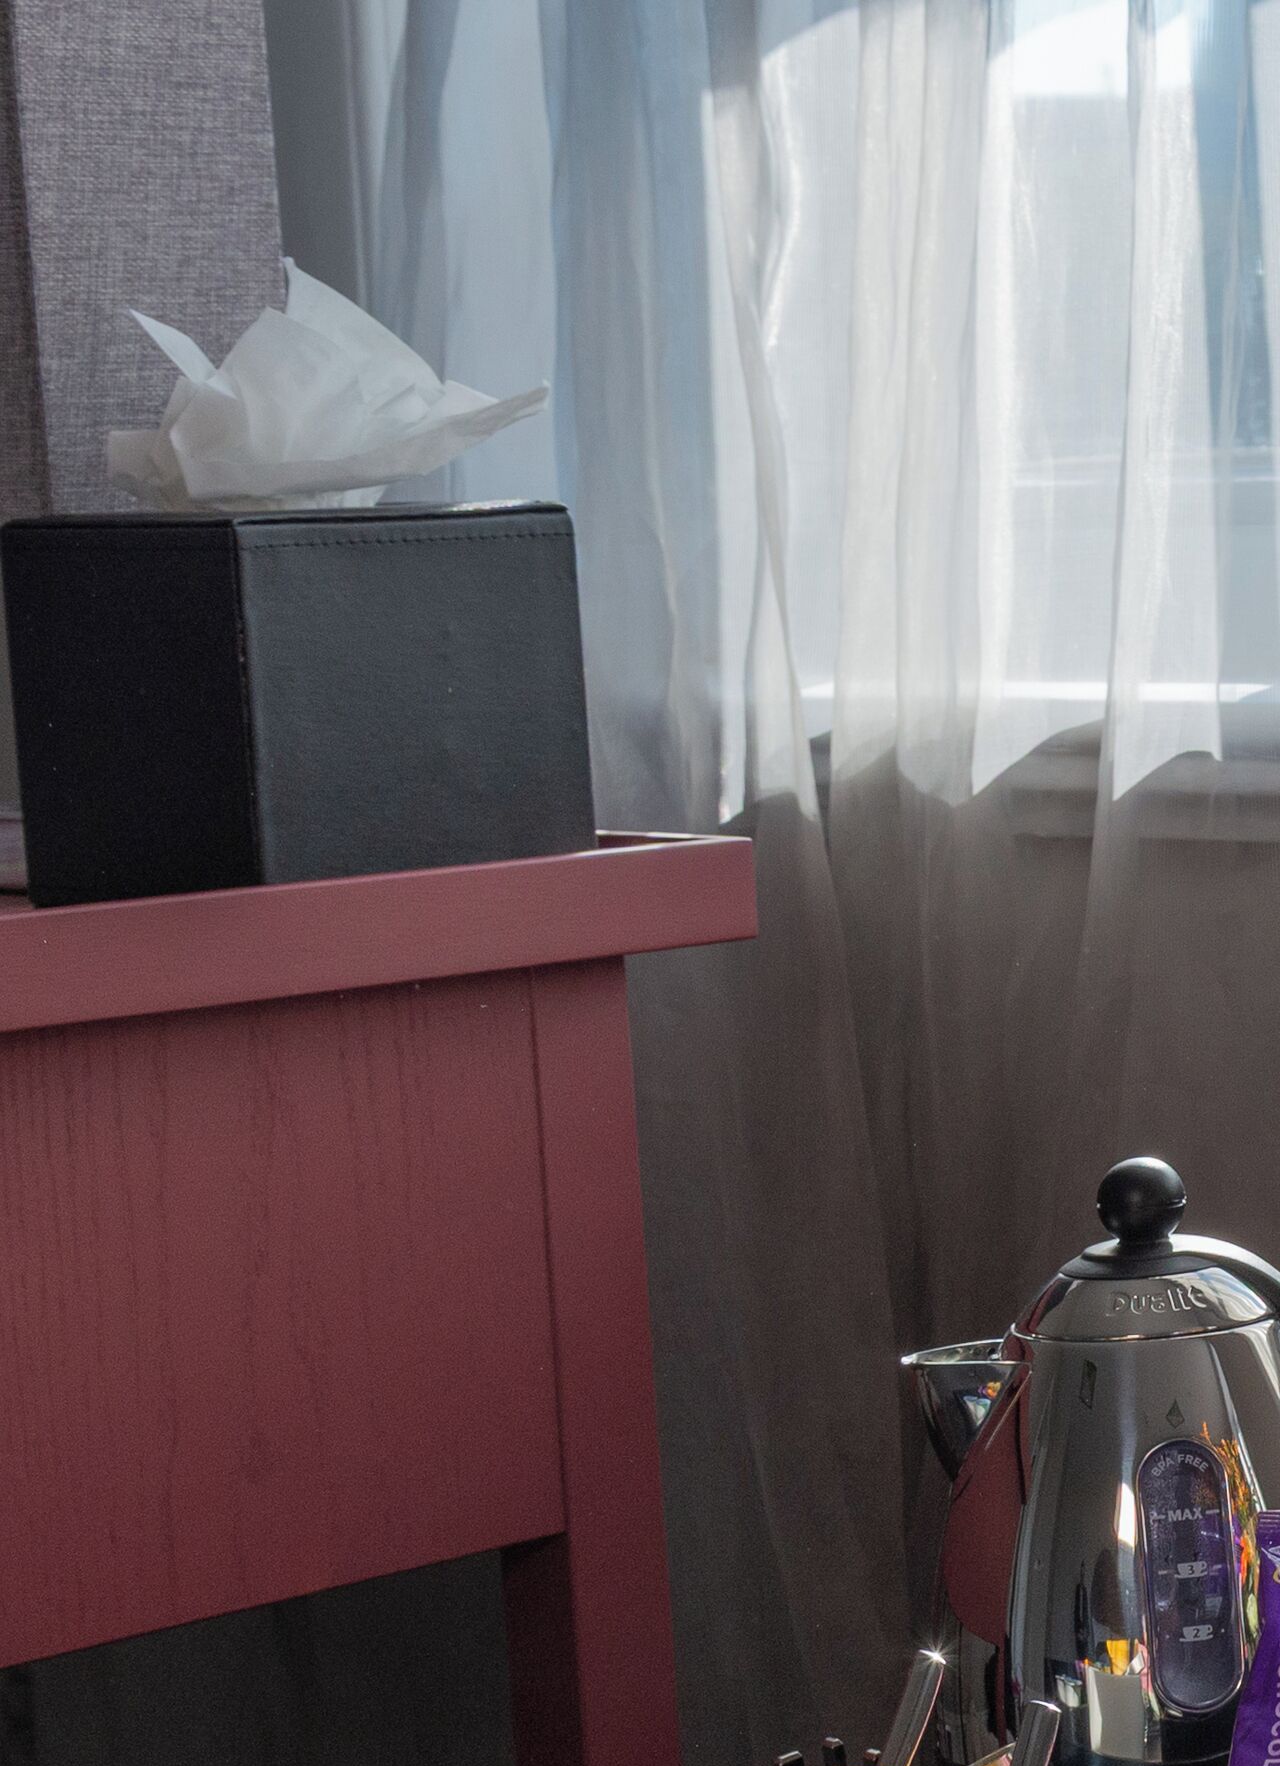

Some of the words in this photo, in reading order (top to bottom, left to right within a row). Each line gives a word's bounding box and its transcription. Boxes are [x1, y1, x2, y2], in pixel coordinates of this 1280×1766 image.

[1151, 1455, 1175, 1478] BPA
[1177, 1453, 1209, 1473] FREE
[1167, 1507, 1204, 1523] MAX
